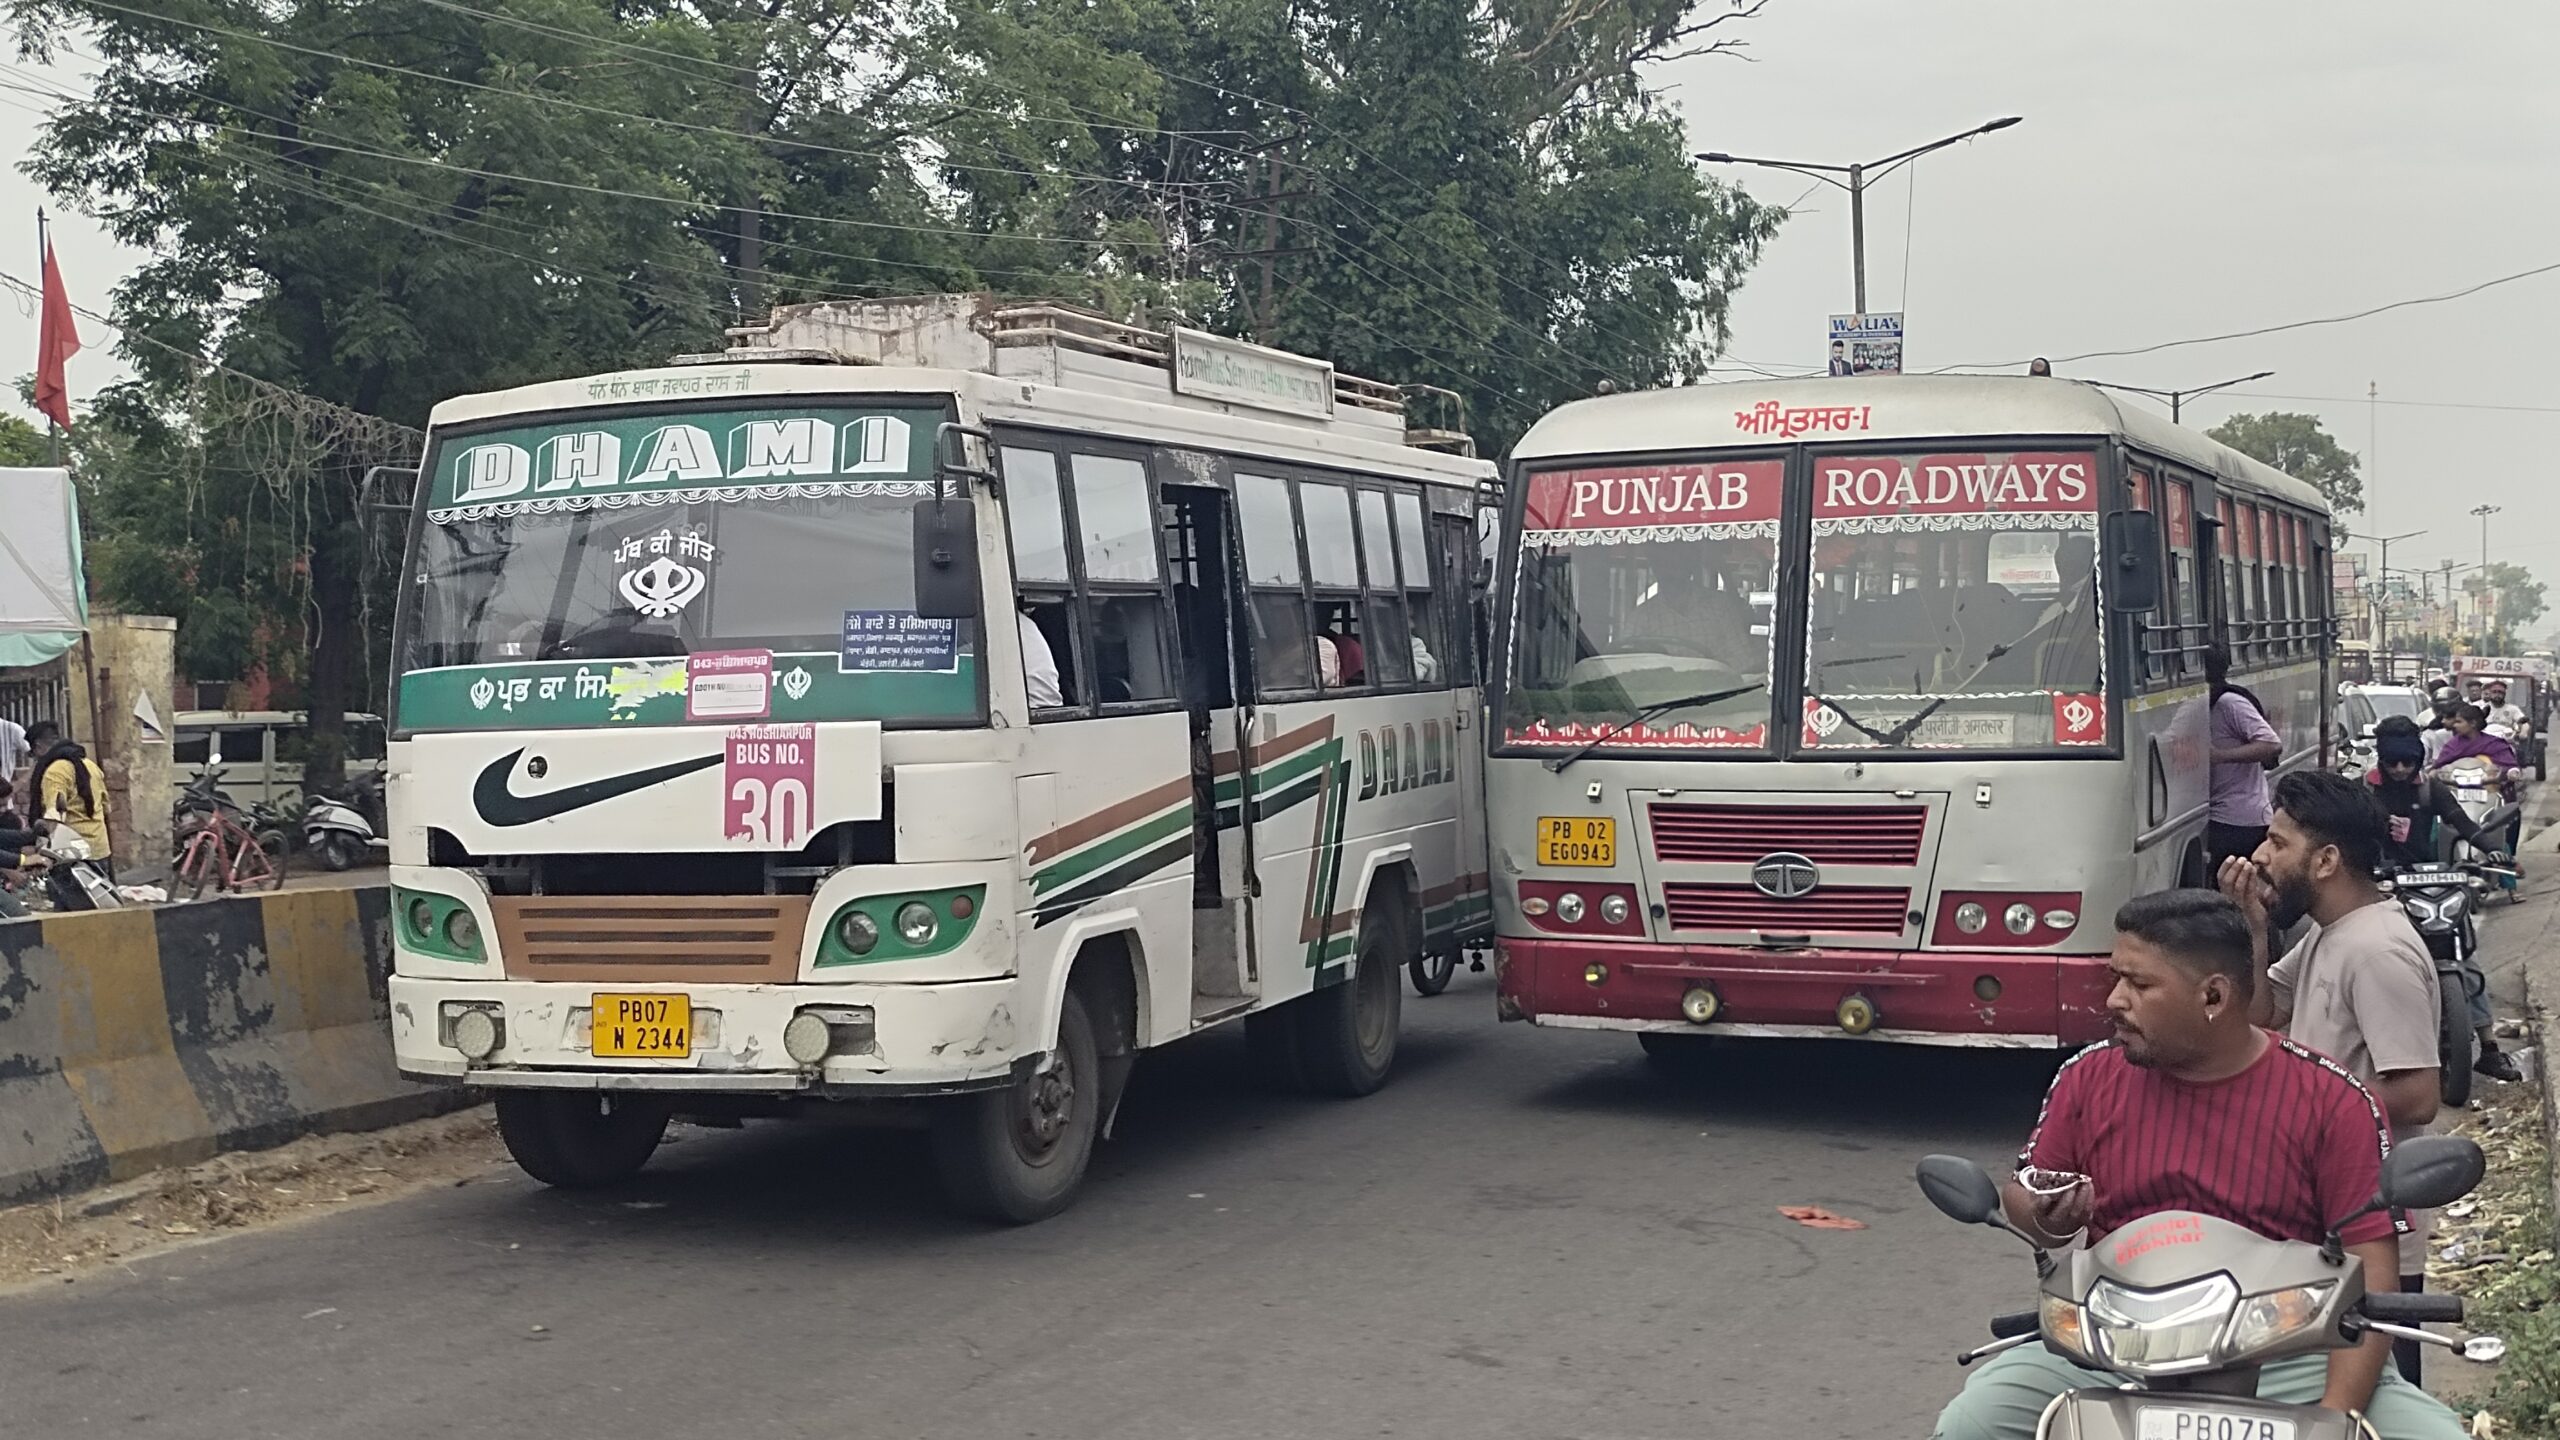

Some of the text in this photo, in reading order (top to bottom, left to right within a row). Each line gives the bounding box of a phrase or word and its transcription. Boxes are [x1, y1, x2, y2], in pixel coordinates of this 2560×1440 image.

[452, 416, 910, 502] DHAMI
[1571, 462, 2088, 518] PUNJAB ROADWAYS
[650, 528, 673, 554] ਕੀ
[679, 531, 716, 562] ਜੀਤ
[2472, 658, 2523, 672] HP GAS
[538, 675, 567, 700] ਕਾ
[736, 743, 804, 764] BUS NO.
[1356, 717, 1455, 802] DHAMI
[732, 777, 808, 848] 30
[1553, 821, 1606, 839] PB 02
[1551, 843, 1610, 861] EG0943
[619, 1000, 668, 1022] PB07
[614, 1026, 685, 1050] N 2344
